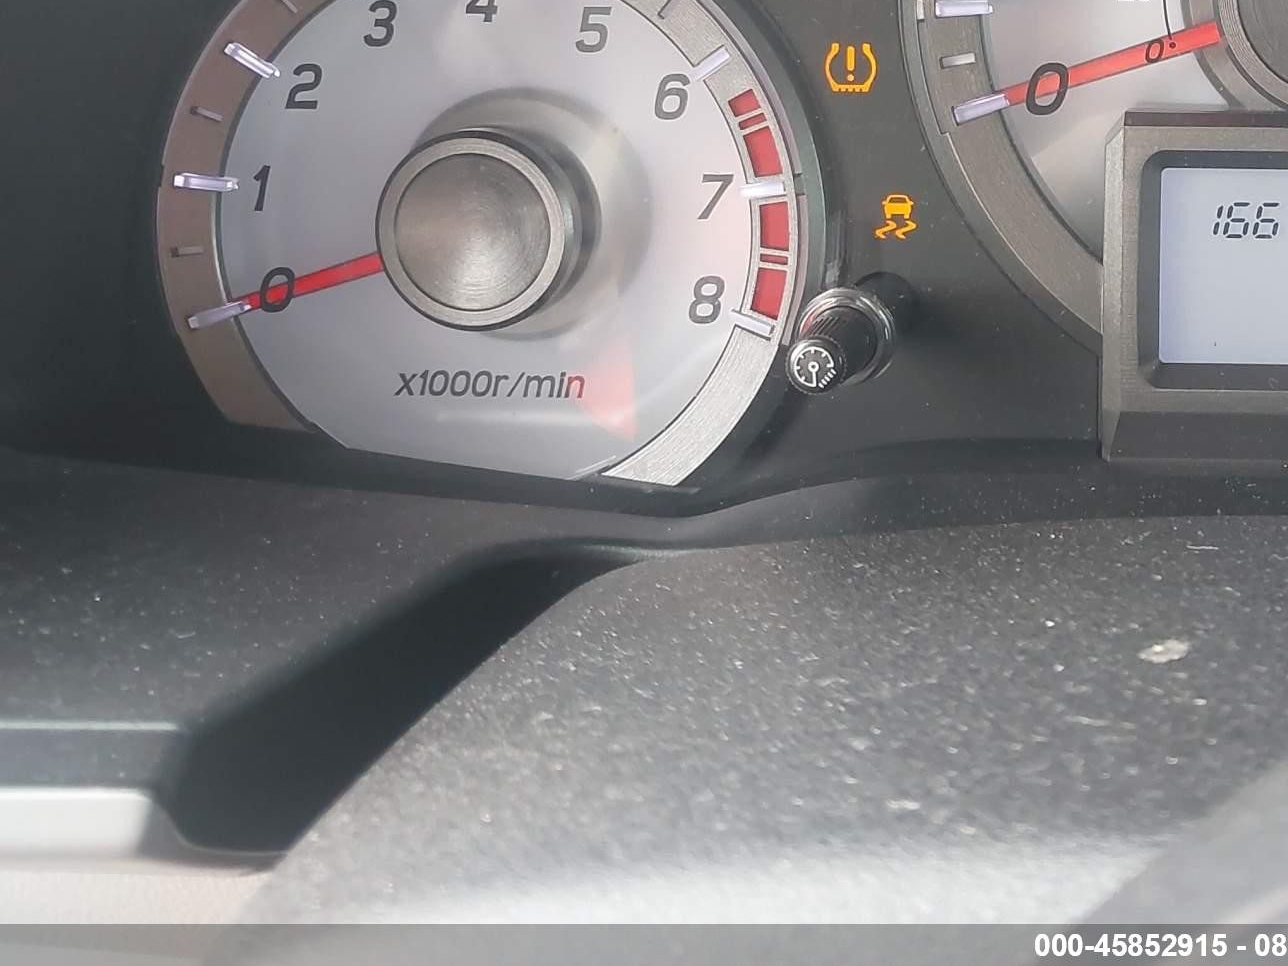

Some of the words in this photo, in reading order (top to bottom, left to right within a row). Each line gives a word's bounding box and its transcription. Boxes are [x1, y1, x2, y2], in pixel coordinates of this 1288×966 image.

[364, 0, 397, 47] 3
[575, 7, 612, 52] 5
[1145, 39, 1164, 63] 0
[285, 64, 322, 109] 2
[655, 74, 690, 120] 6
[1025, 63, 1069, 115] 0
[253, 165, 270, 211] 1
[697, 174, 734, 219] 7
[260, 267, 295, 313] 0
[689, 276, 724, 324] 8
[393, 370, 584, 399] x1000r/min
